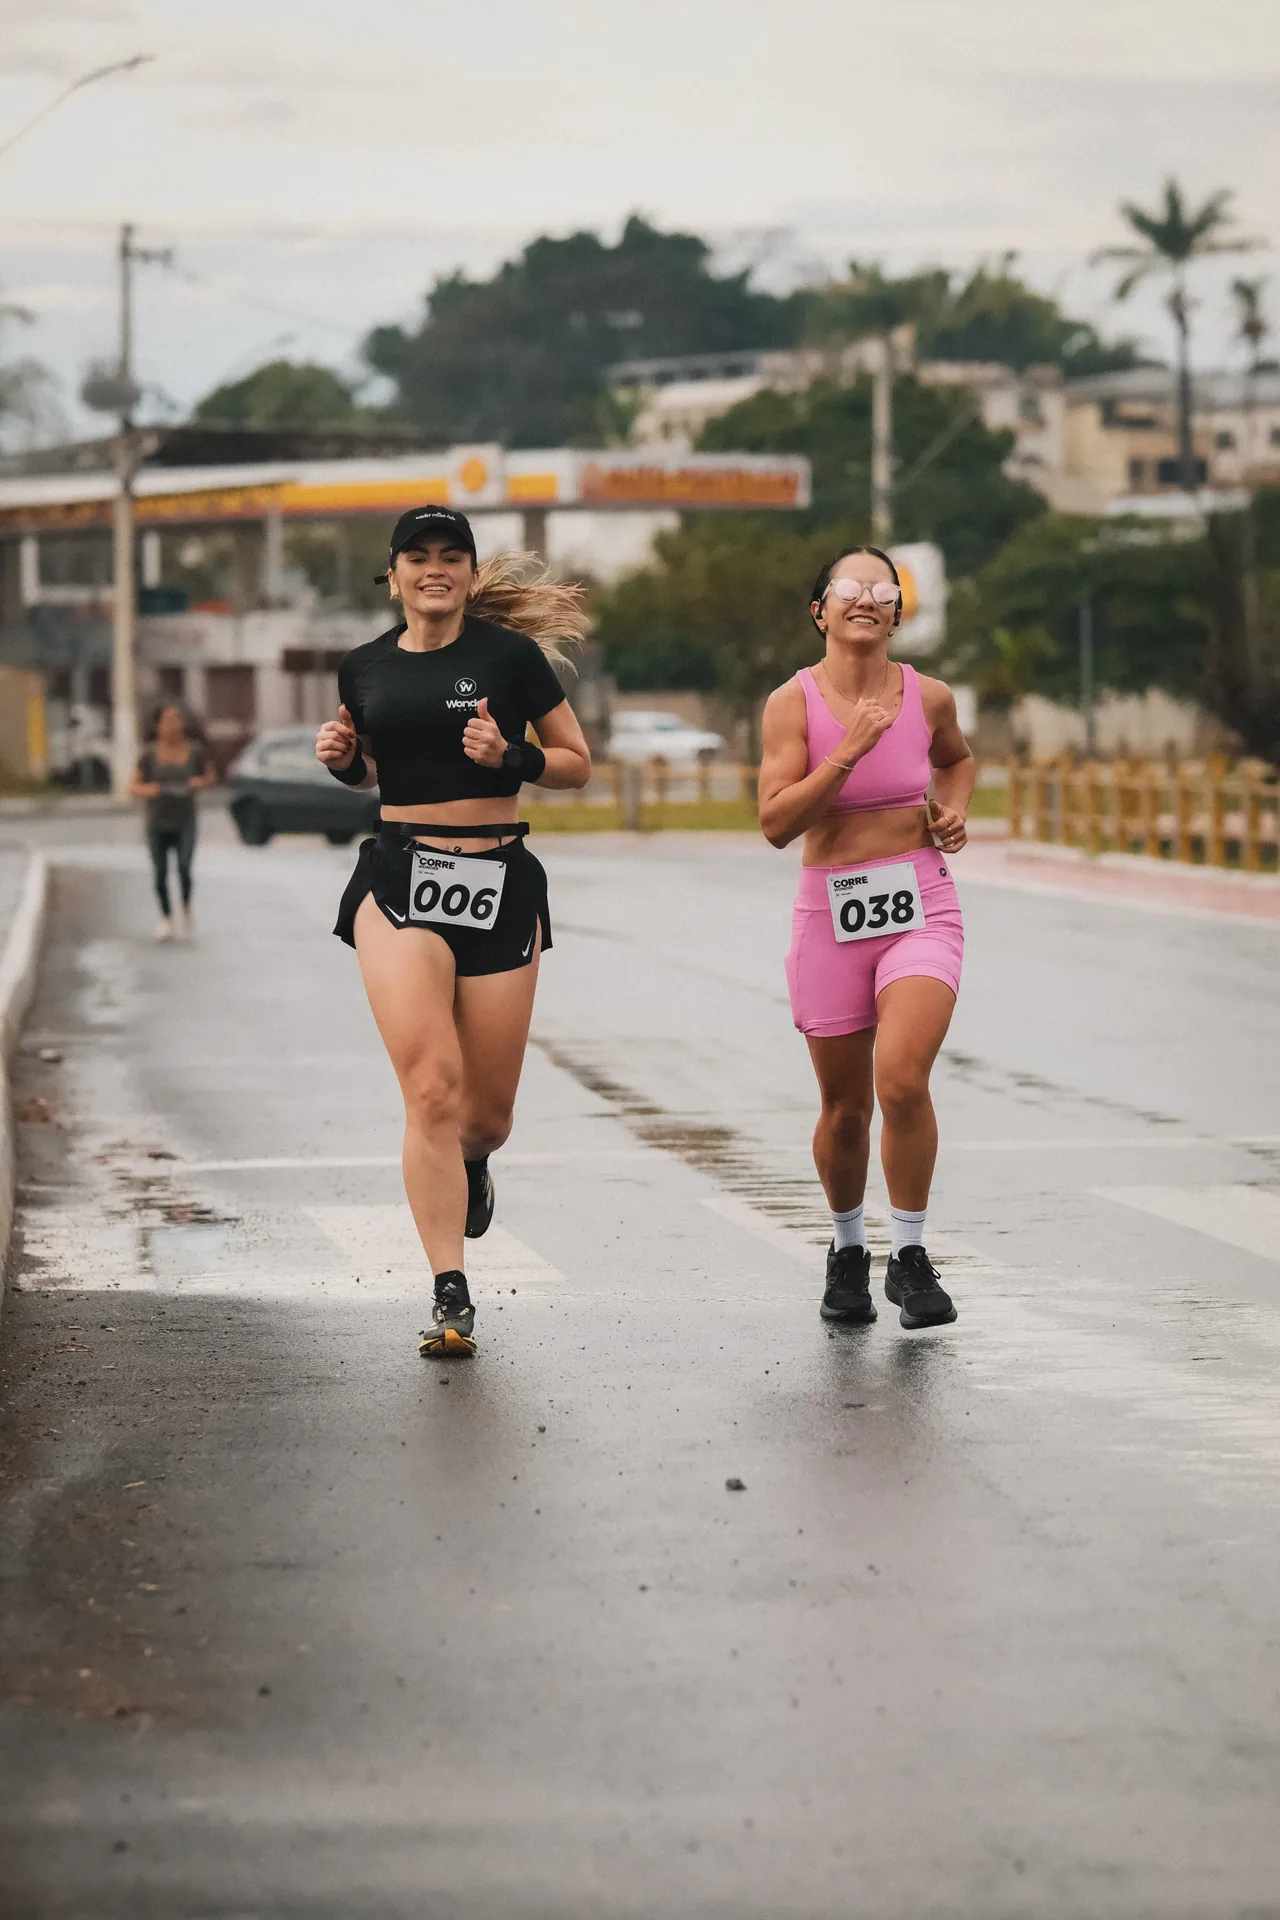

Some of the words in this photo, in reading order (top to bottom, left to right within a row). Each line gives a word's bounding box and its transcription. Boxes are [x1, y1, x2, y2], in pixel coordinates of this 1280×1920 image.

[419, 857, 455, 870] CORRE
[833, 876, 868, 888] CORRE
[414, 880, 498, 920] 006
[840, 890, 914, 932] 038
